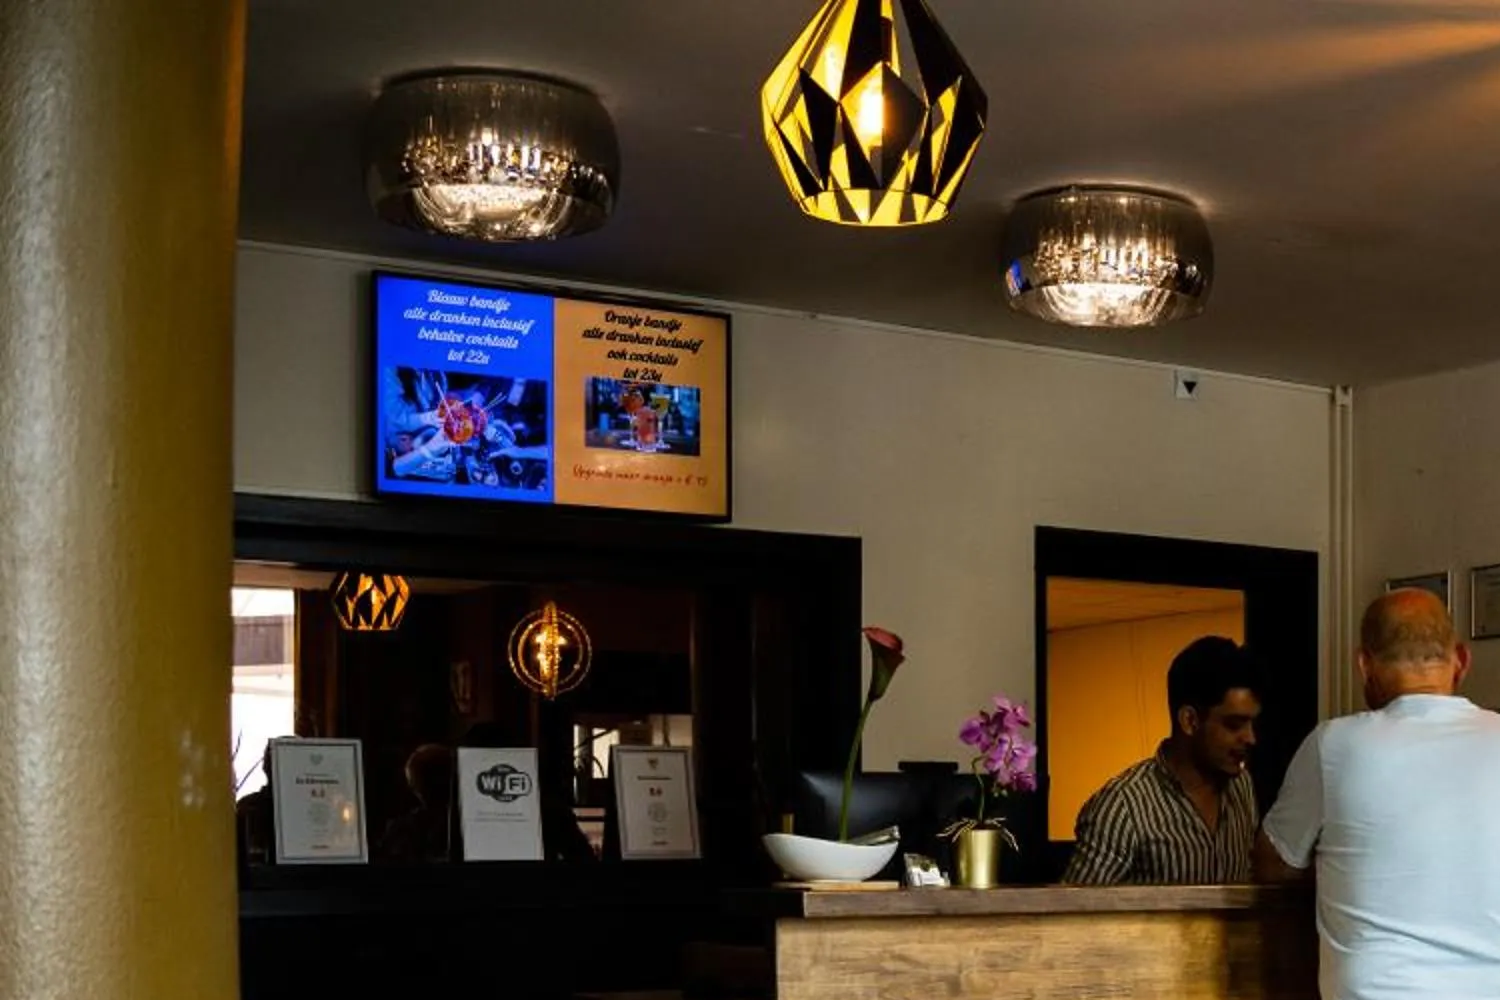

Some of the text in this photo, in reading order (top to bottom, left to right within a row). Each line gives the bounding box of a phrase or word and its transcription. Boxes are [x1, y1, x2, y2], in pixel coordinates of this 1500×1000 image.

[469, 295, 511, 314] bandje
[403, 307, 535, 335] alle dranken inclusief
[605, 309, 682, 333] Oranje bandje
[417, 326, 519, 349] behalve cocktails
[582, 327, 704, 354] alle dranken inclusief
[447, 348, 490, 364] tot 22u
[607, 348, 678, 366] ook cocktails
[623, 367, 663, 382] tot 23u
